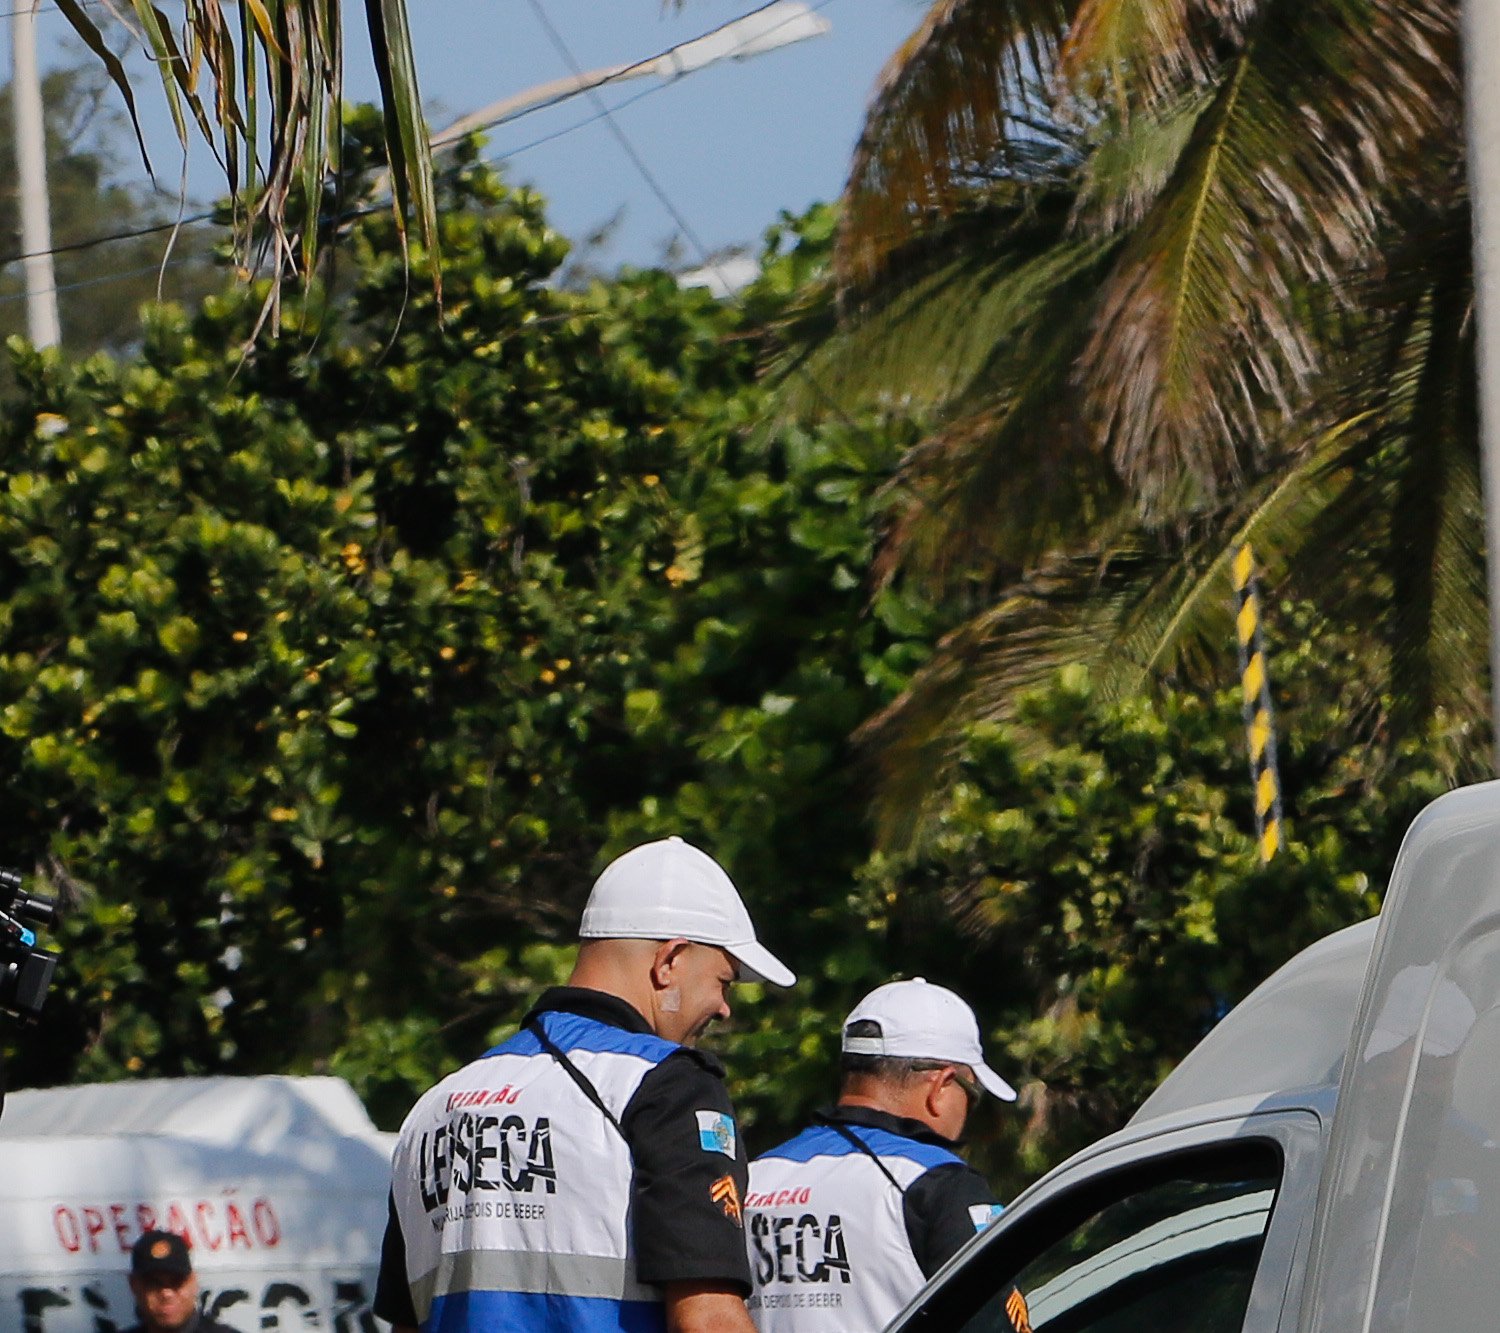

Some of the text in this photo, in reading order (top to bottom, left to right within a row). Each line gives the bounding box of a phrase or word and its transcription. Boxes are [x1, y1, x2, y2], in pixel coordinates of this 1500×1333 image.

[453, 1113, 557, 1195] SECA
[496, 1203, 511, 1218] DE
[513, 1203, 545, 1219] BEBER
[752, 1213, 851, 1287] SECA
[808, 1293, 842, 1309] BEBER
